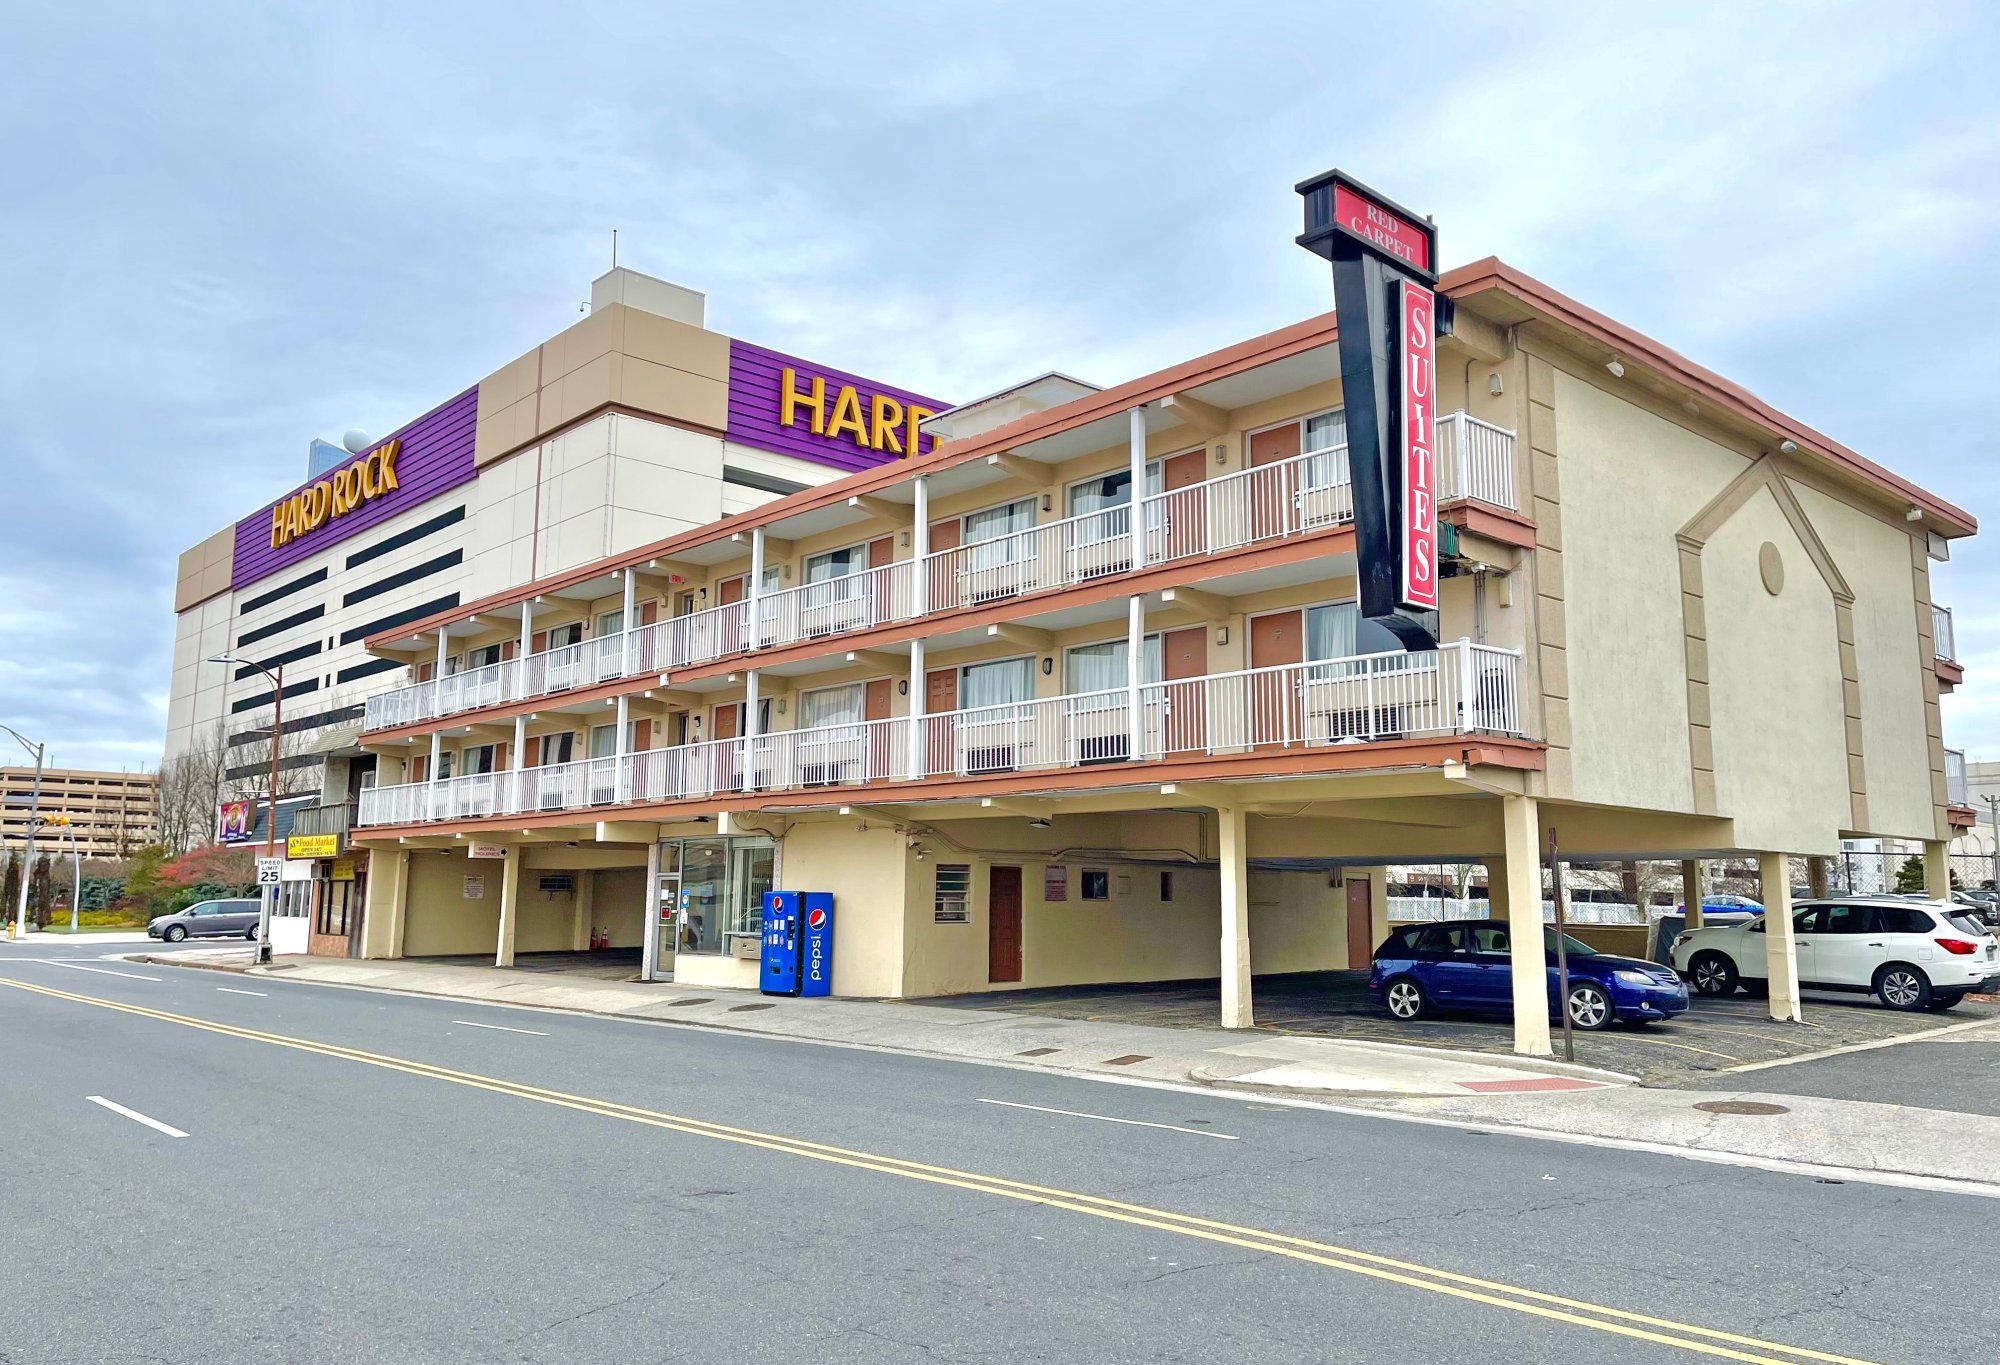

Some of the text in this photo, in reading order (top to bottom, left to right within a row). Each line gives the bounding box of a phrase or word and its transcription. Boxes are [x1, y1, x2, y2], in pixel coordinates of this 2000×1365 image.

[1351, 216, 1414, 261] CARPET
[1366, 203, 1398, 233] RED
[1410, 306, 1431, 581] SUITES
[270, 438, 401, 549] HARD ROCK
[299, 837, 314, 847] Food
[315, 836, 335, 846] Market
[261, 872, 279, 882] 25
[811, 934, 822, 981] pepsi
